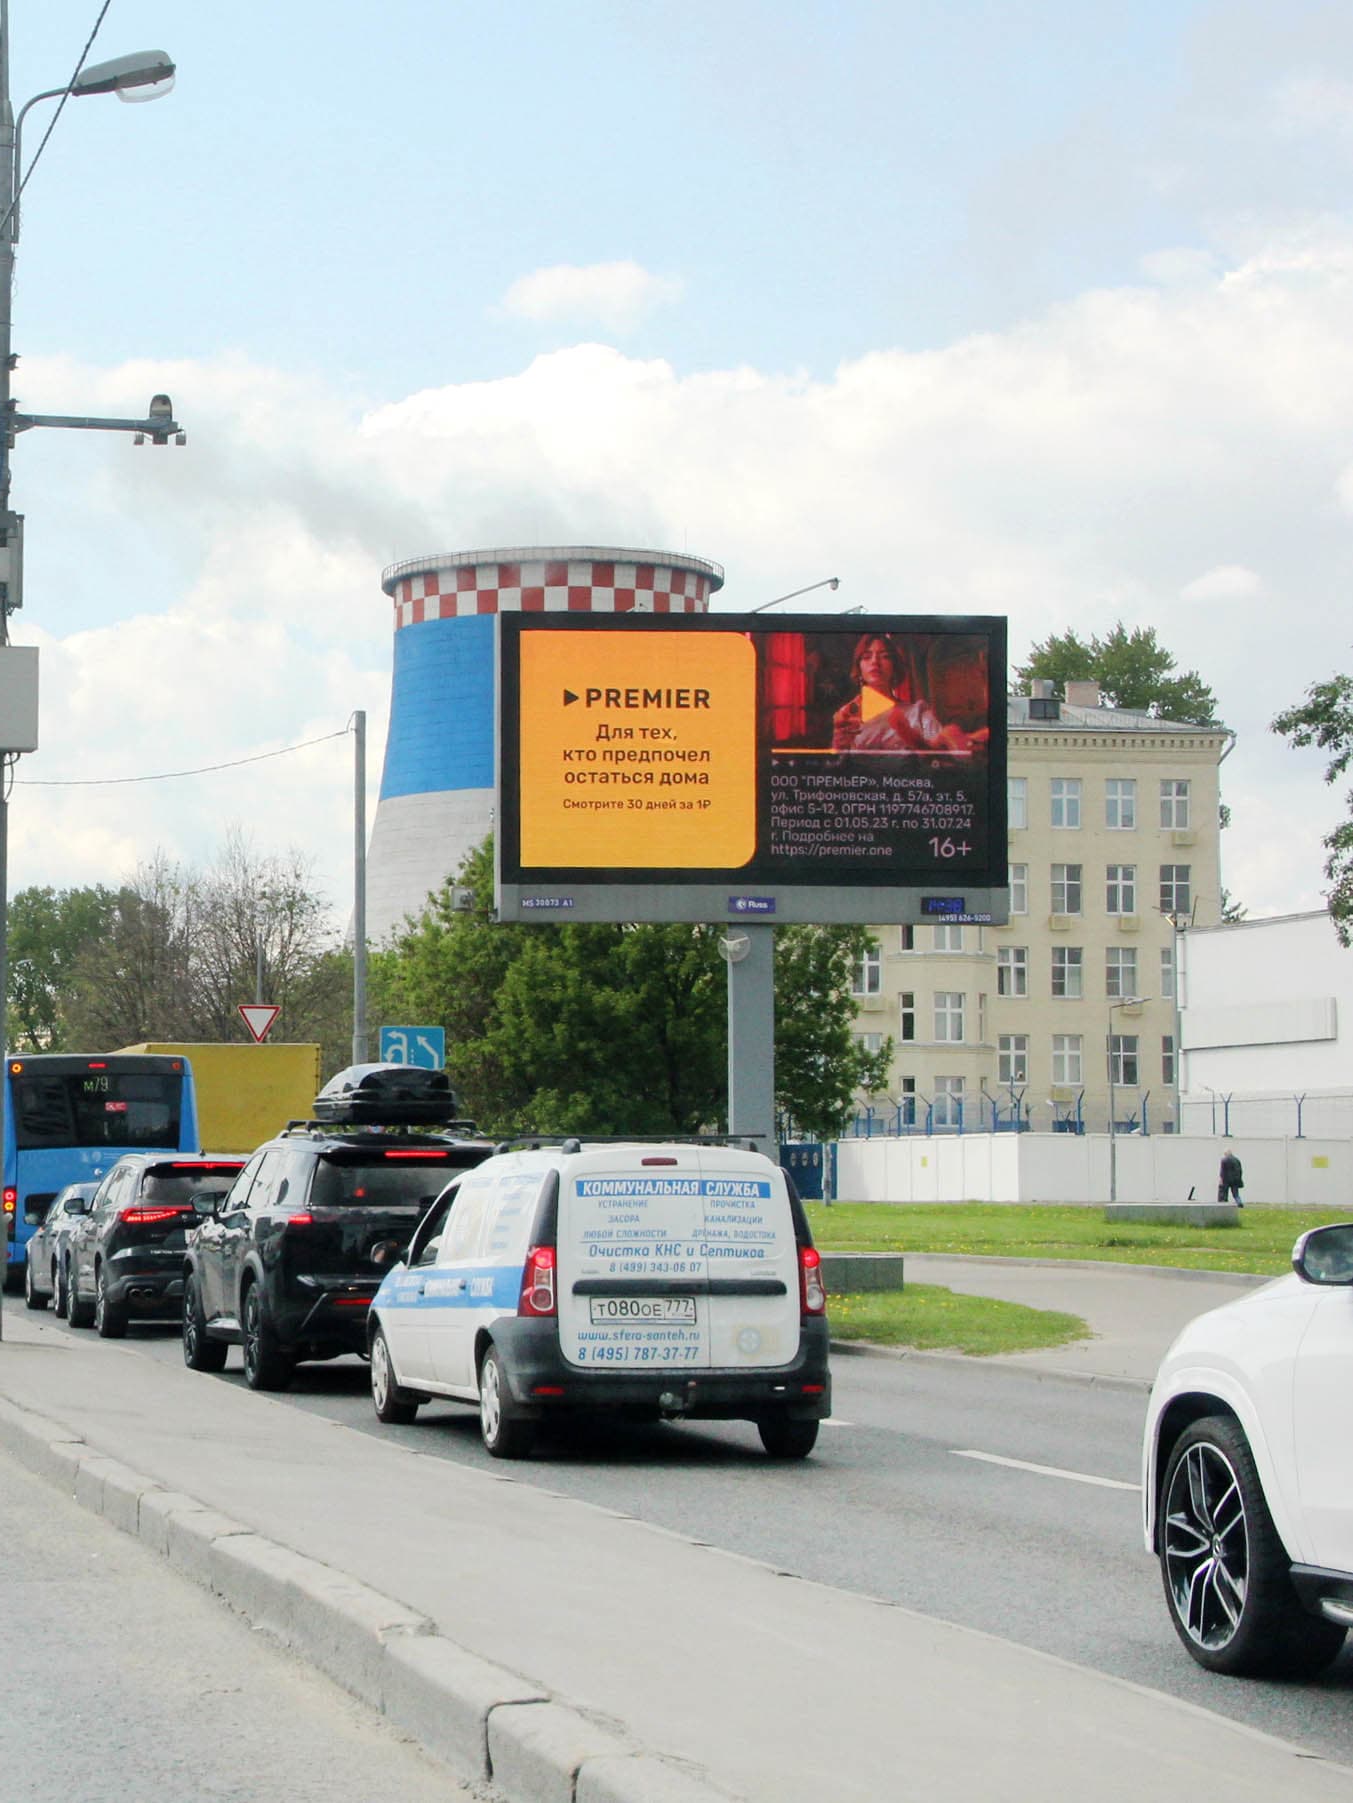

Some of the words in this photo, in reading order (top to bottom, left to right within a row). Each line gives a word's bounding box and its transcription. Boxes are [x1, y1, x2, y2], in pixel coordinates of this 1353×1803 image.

[586, 688, 710, 708] PREMIER
[596, 724, 634, 741] Для
[639, 727, 677, 741] тех,
[563, 749, 597, 761] кто
[602, 749, 710, 764] предпочел
[564, 771, 654, 784] остаться
[659, 772, 709, 786] дома
[770, 775, 798, 787] ООО
[563, 799, 624, 811] Смотрите
[627, 799, 643, 809] 30
[646, 799, 676, 810] дней
[679, 800, 694, 809] за
[770, 803, 805, 816] офис
[841, 803, 876, 815] ОГРН
[770, 816, 821, 830] Период
[823, 819, 831, 828] с
[834, 817, 888, 829] 01.05.23
[902, 820, 919, 829] по
[922, 817, 971, 829] 31.07.24
[782, 830, 855, 843] Подробнее
[858, 832, 874, 841] на
[770, 843, 892, 857] https://premier.one
[928, 836, 972, 858] 16+
[583, 1180, 699, 1196] КОММУНАЛЬНАЯ
[705, 1181, 760, 1197] СЛУЖБА
[598, 1199, 648, 1209] УСТРАНЕНИЕ
[710, 1199, 756, 1209] ПРОЧИСТКА
[607, 1214, 640, 1224] ЗАСОРА
[704, 1215, 763, 1225] КАНАЛИЗАЦИИ
[616, 1229, 667, 1238] СЛОЖНОСТИ
[588, 1243, 649, 1258] Очистка
[654, 1243, 682, 1257] КНС
[686, 1246, 695, 1257] и
[699, 1243, 765, 1259] Септиков
[609, 1262, 616, 1272] 8
[619, 1262, 647, 1273] (499)
[577, 1329, 700, 1341] www.sfera-santeh.ru
[578, 1346, 587, 1361] 8
[592, 1346, 629, 1361] (495)
[634, 1346, 699, 1361] 787-37-77
